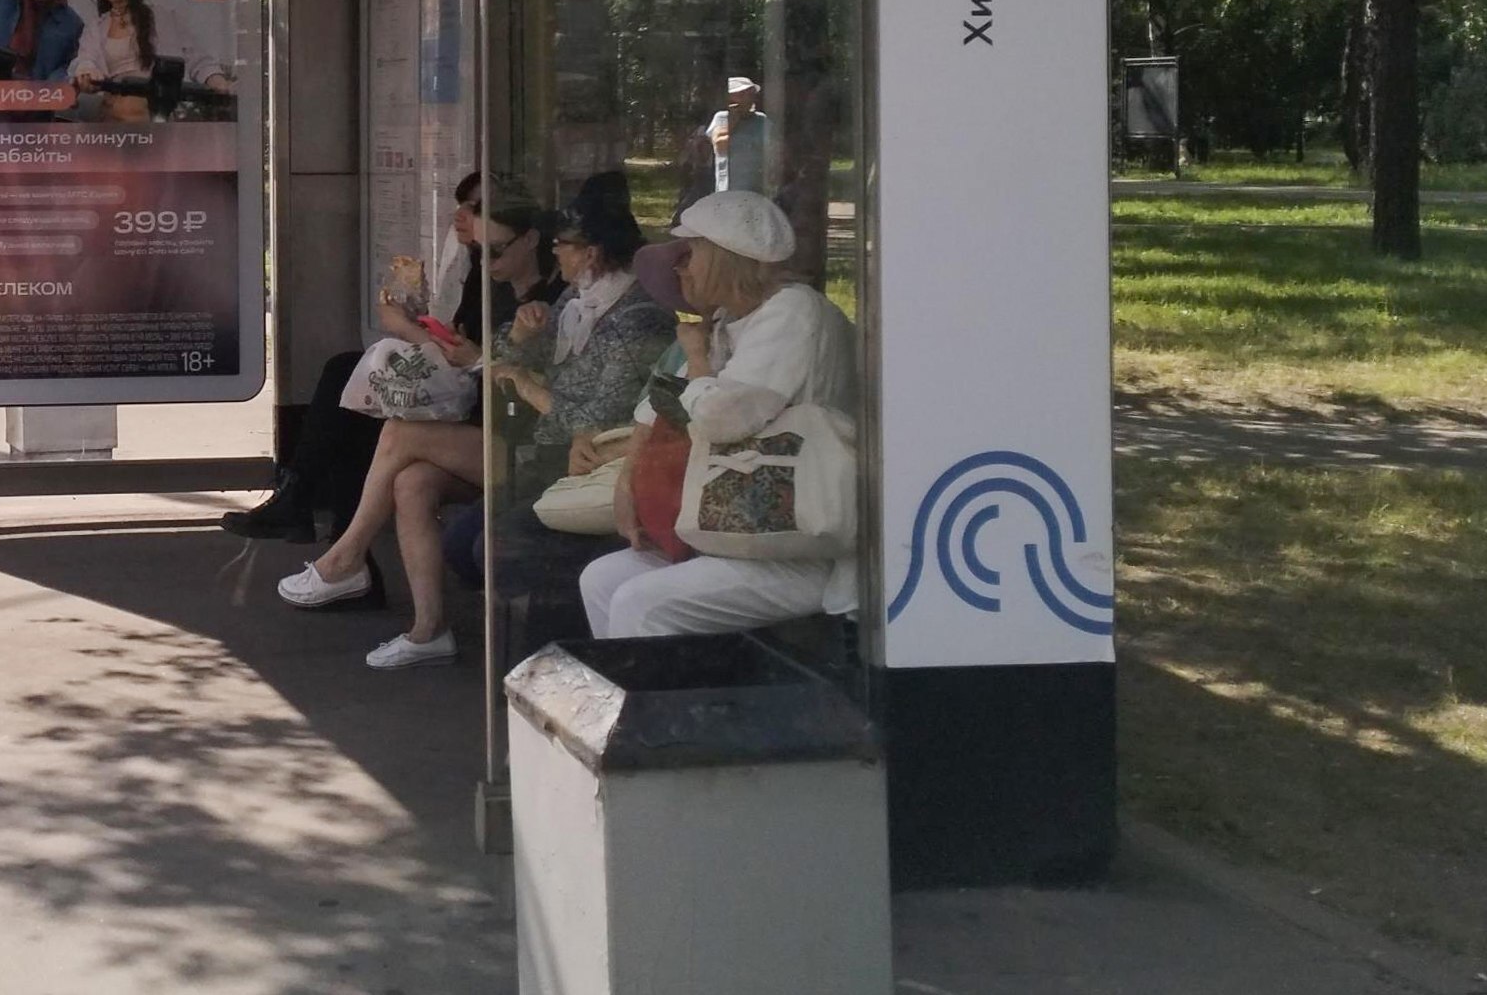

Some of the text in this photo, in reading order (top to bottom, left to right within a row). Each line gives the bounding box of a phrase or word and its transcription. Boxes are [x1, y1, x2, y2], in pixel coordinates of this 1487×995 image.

[38, 87, 64, 103] 24
[75, 132, 154, 148] минуты
[113, 210, 179, 234] 399
[180, 351, 216, 373] 18+
